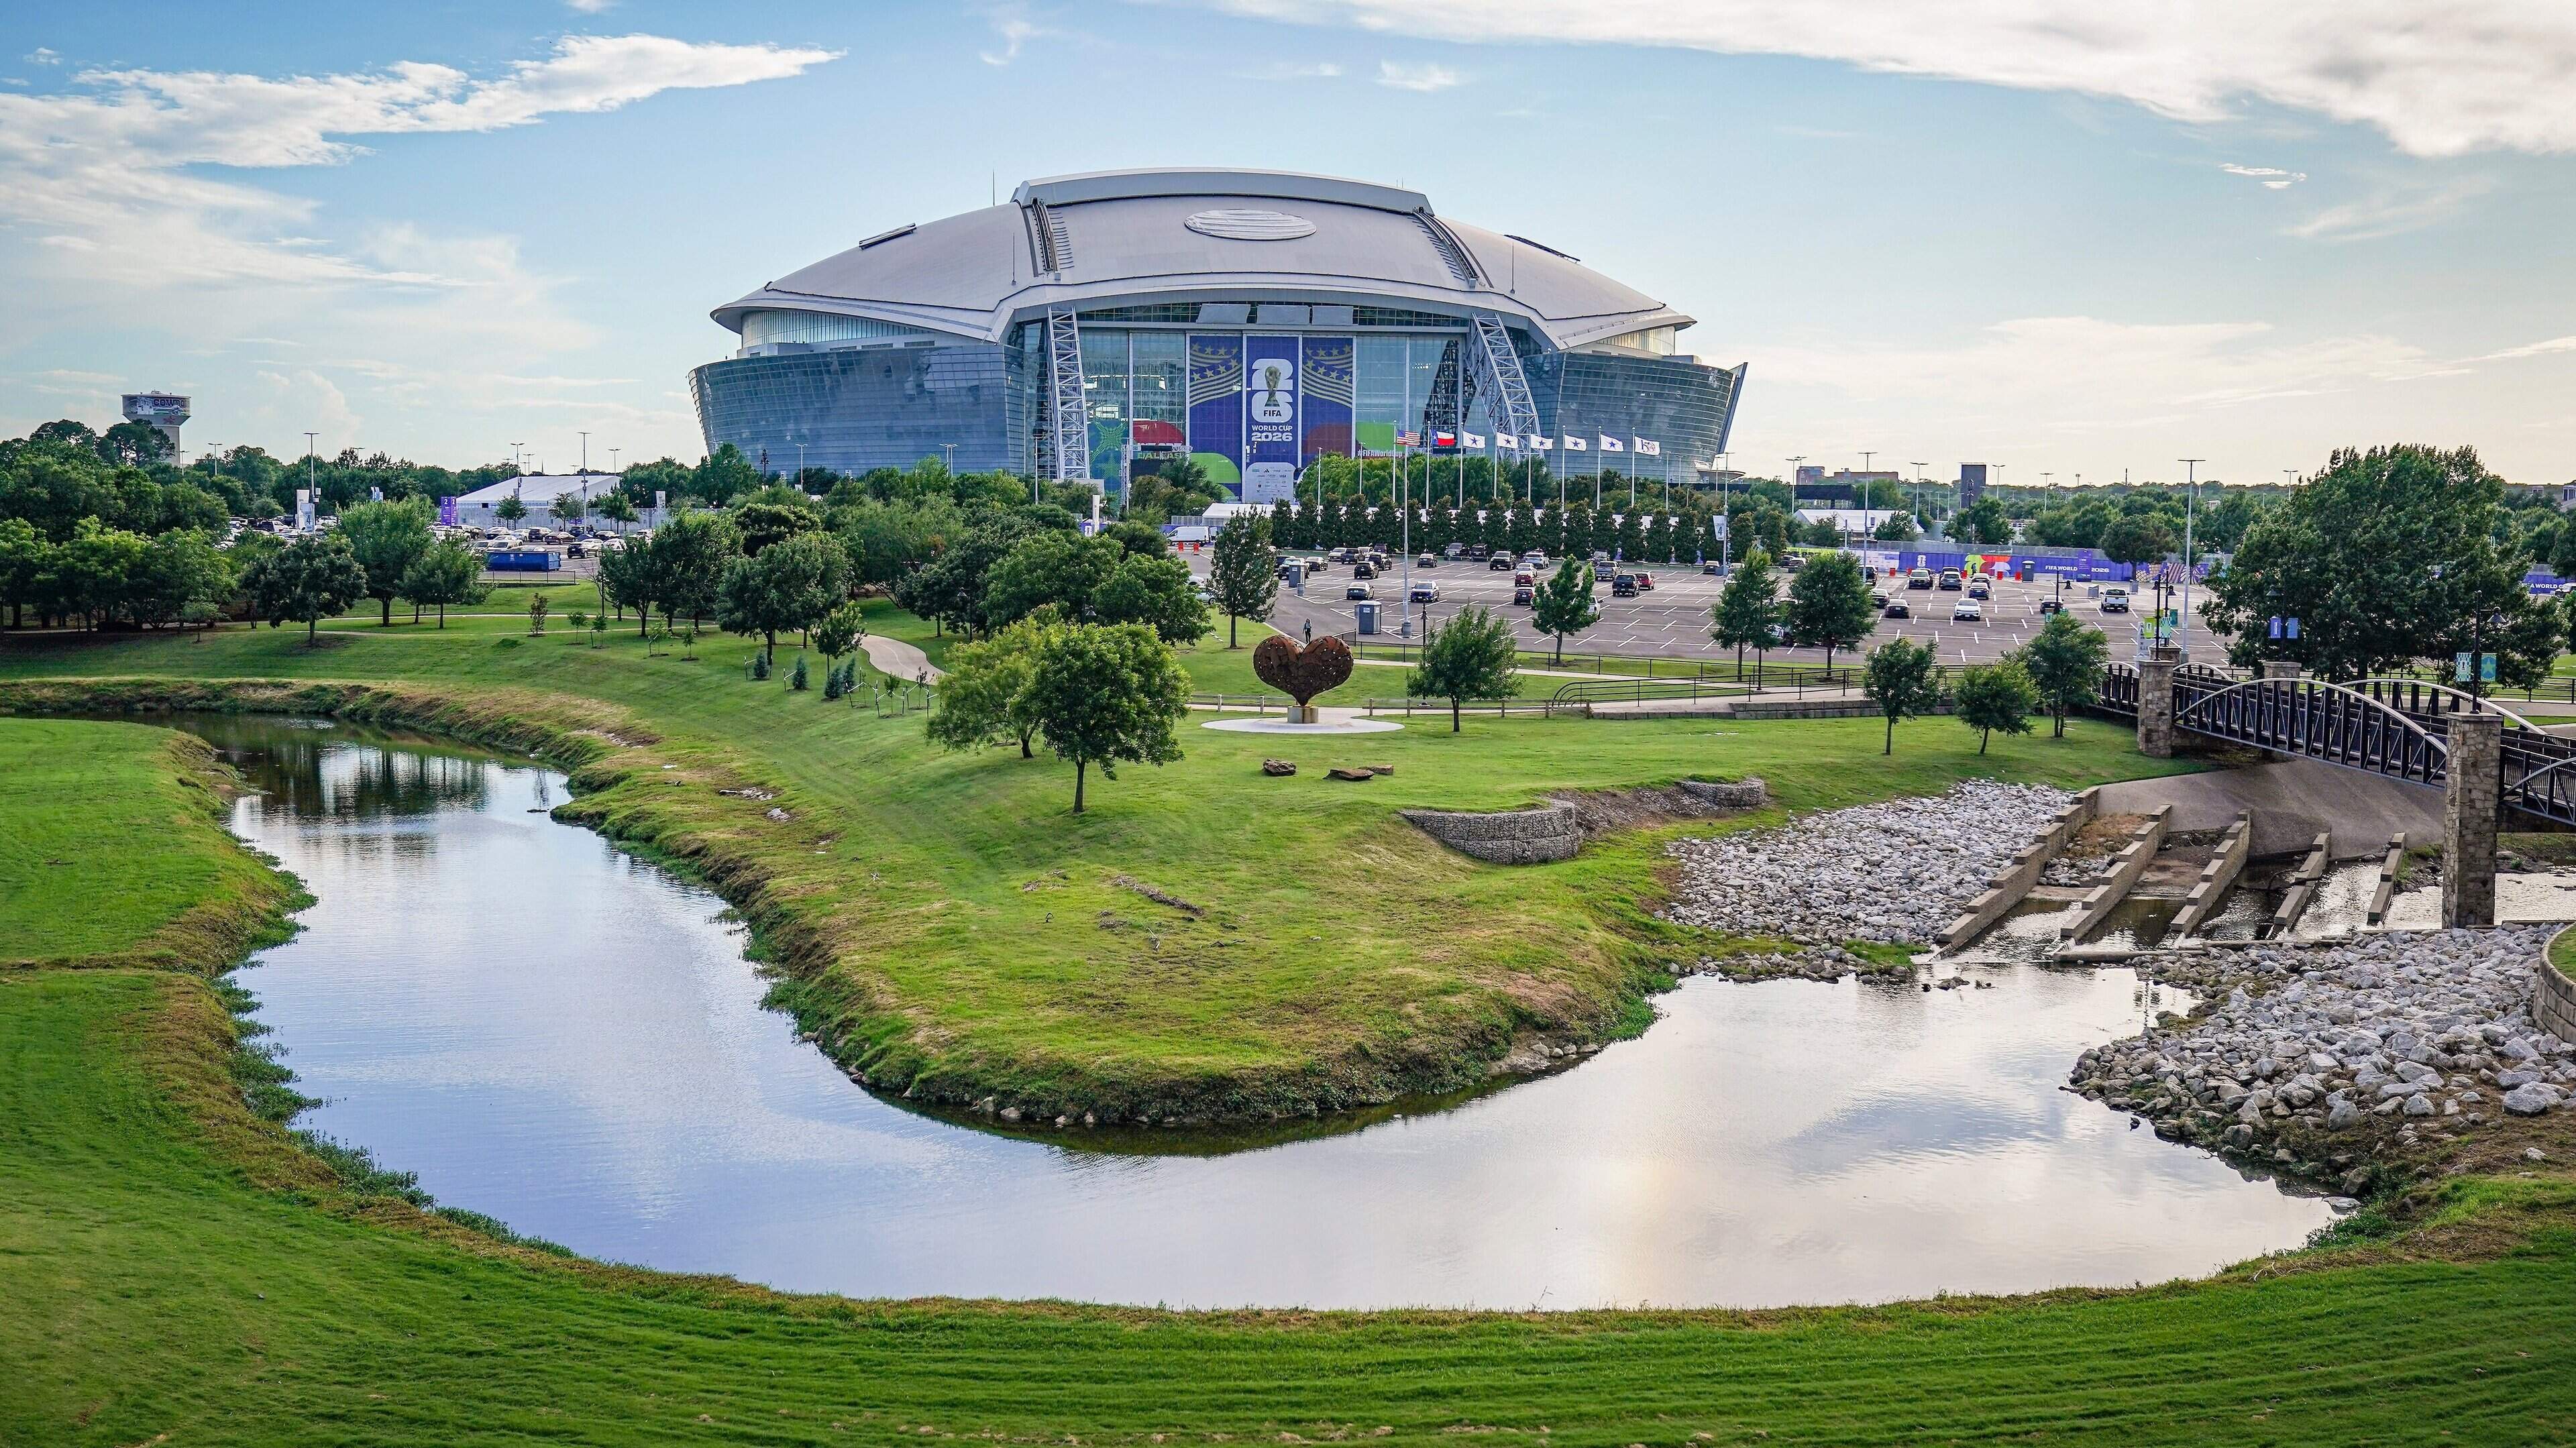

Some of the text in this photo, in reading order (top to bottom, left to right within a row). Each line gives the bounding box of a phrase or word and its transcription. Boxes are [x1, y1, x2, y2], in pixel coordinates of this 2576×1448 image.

[1252, 432, 1293, 442] 2026
[307, 515, 311, 524] 4
[1718, 526, 1722, 535] 4
